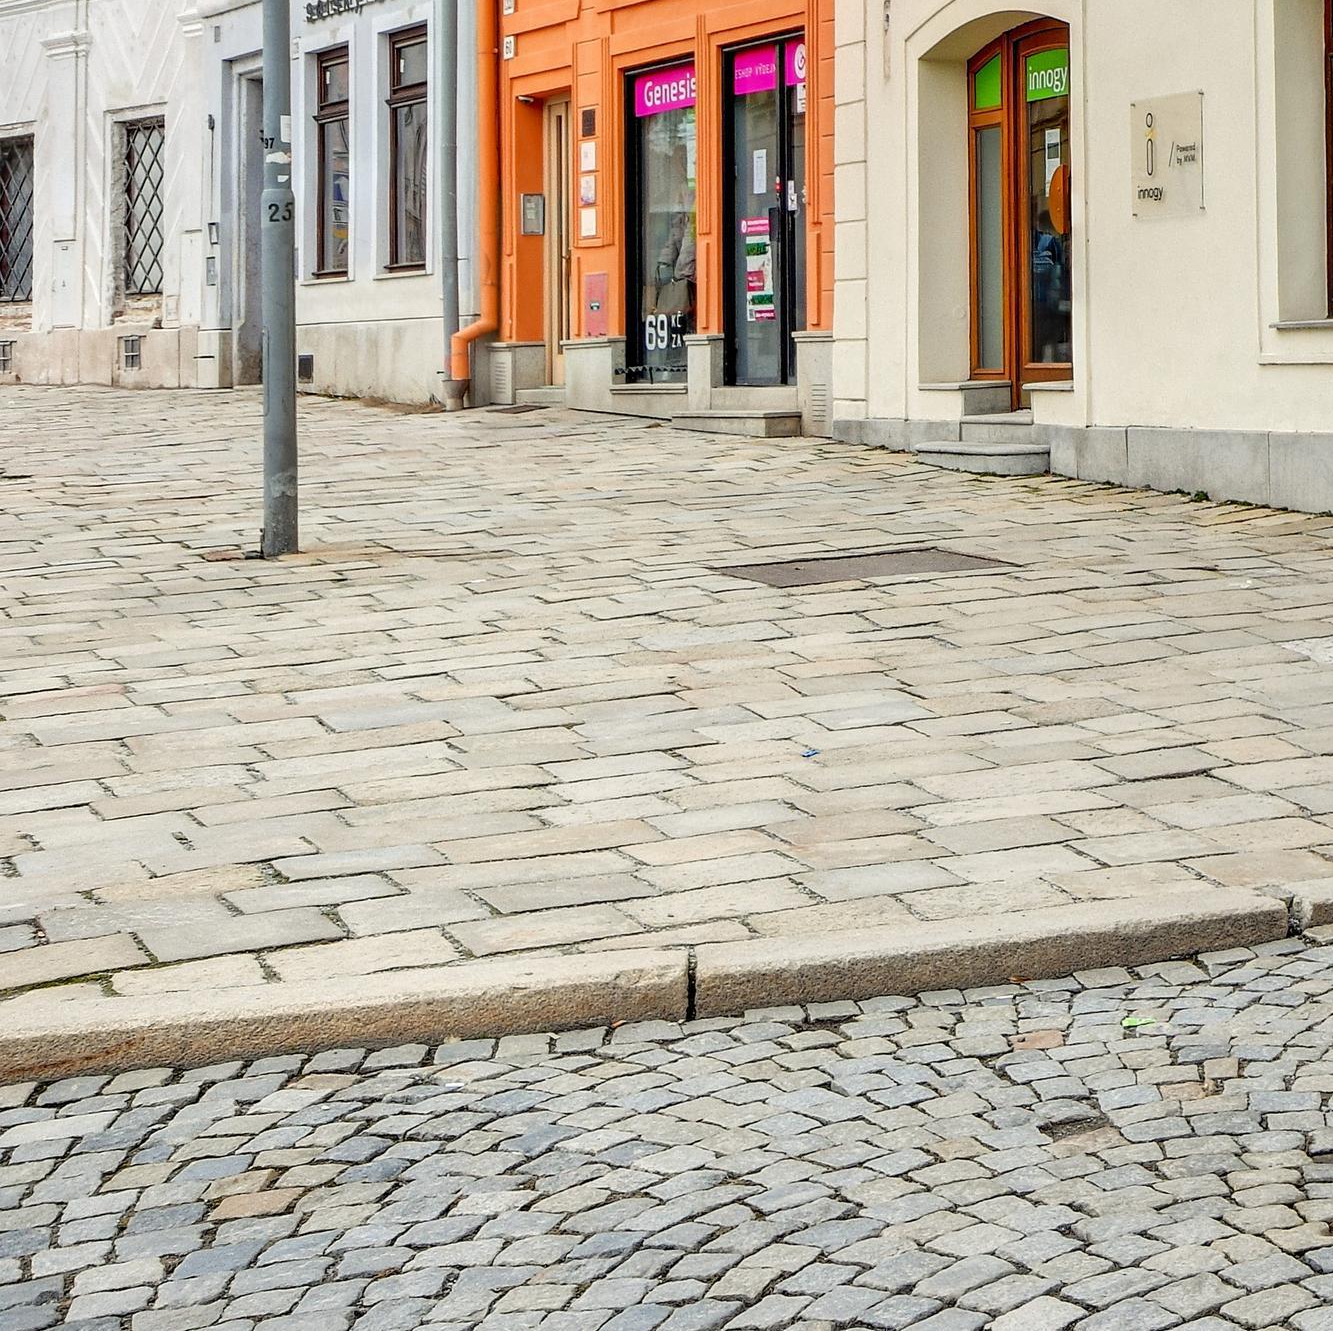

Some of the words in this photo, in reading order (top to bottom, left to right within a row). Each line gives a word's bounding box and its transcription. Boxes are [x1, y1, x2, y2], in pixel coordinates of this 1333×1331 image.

[643, 72, 696, 108] Genesis
[1028, 65, 1068, 93] innogy
[1176, 142, 1196, 153] Powered
[1137, 185, 1164, 202] innogy
[268, 201, 294, 223] 25
[645, 313, 668, 351] 69
[671, 310, 682, 328] KČ
